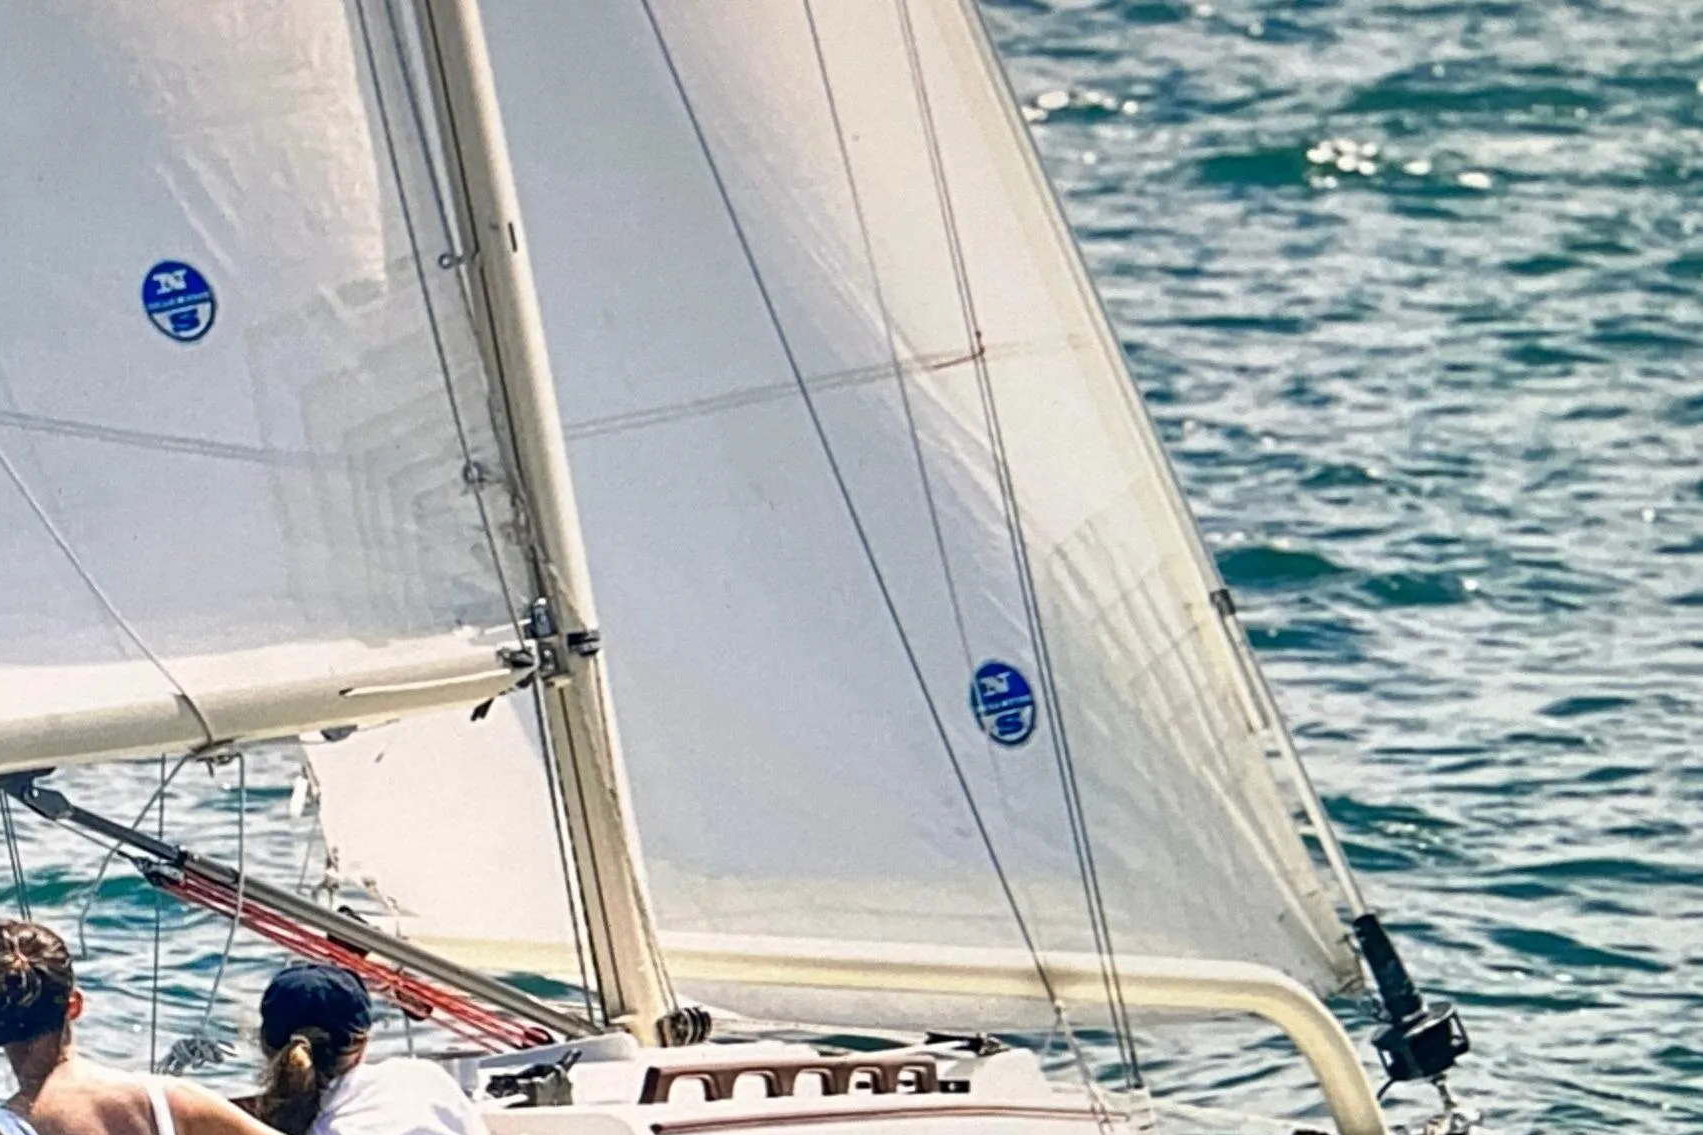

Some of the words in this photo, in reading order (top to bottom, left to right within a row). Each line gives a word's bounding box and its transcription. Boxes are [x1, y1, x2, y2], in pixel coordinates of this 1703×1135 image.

[152, 269, 187, 295] N
[169, 308, 201, 333] S
[979, 671, 1011, 697] N
